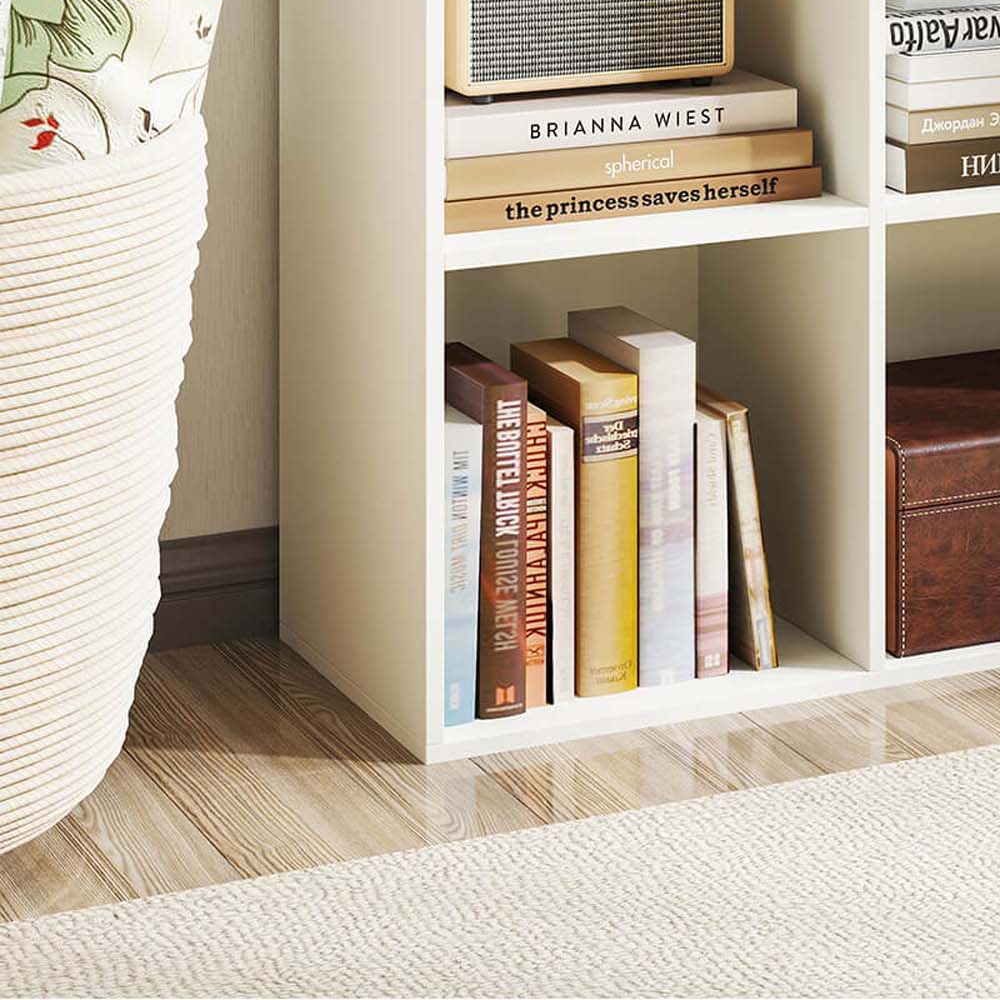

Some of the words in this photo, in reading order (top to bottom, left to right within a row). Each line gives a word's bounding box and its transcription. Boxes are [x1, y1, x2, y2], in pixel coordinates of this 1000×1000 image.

[889, 17, 959, 52] Aalto
[530, 115, 642, 140] BRIANNA
[654, 107, 726, 128] WIEST
[921, 116, 985, 134] Джордан
[604, 150, 675, 178] spherical
[505, 201, 542, 220] the
[545, 193, 639, 221] princess
[642, 187, 701, 206] saves
[703, 177, 779, 201] herself
